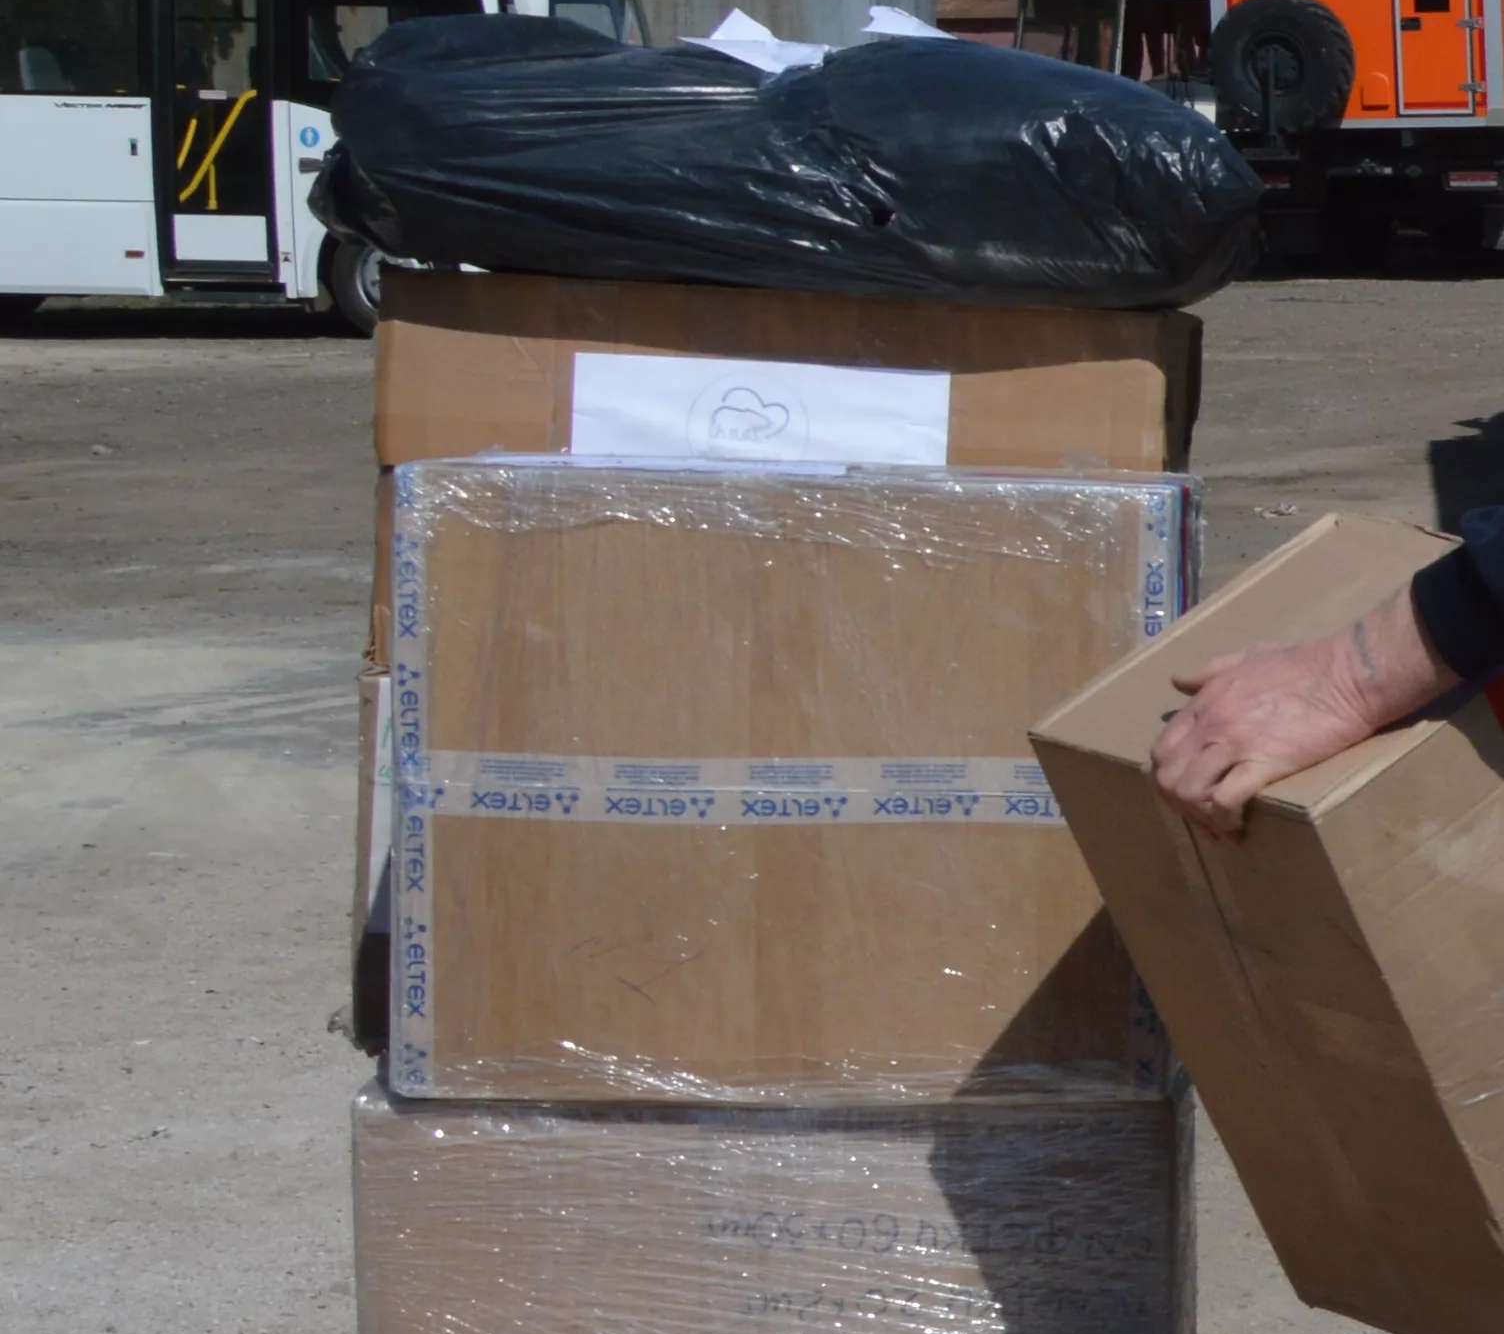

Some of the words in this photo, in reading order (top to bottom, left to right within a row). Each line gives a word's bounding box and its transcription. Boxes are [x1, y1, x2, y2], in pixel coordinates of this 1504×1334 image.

[471, 791, 553, 814] ELTEX
[605, 793, 689, 816] ELTEX
[741, 794, 823, 818] ELTEX
[873, 793, 954, 817] ELTEX
